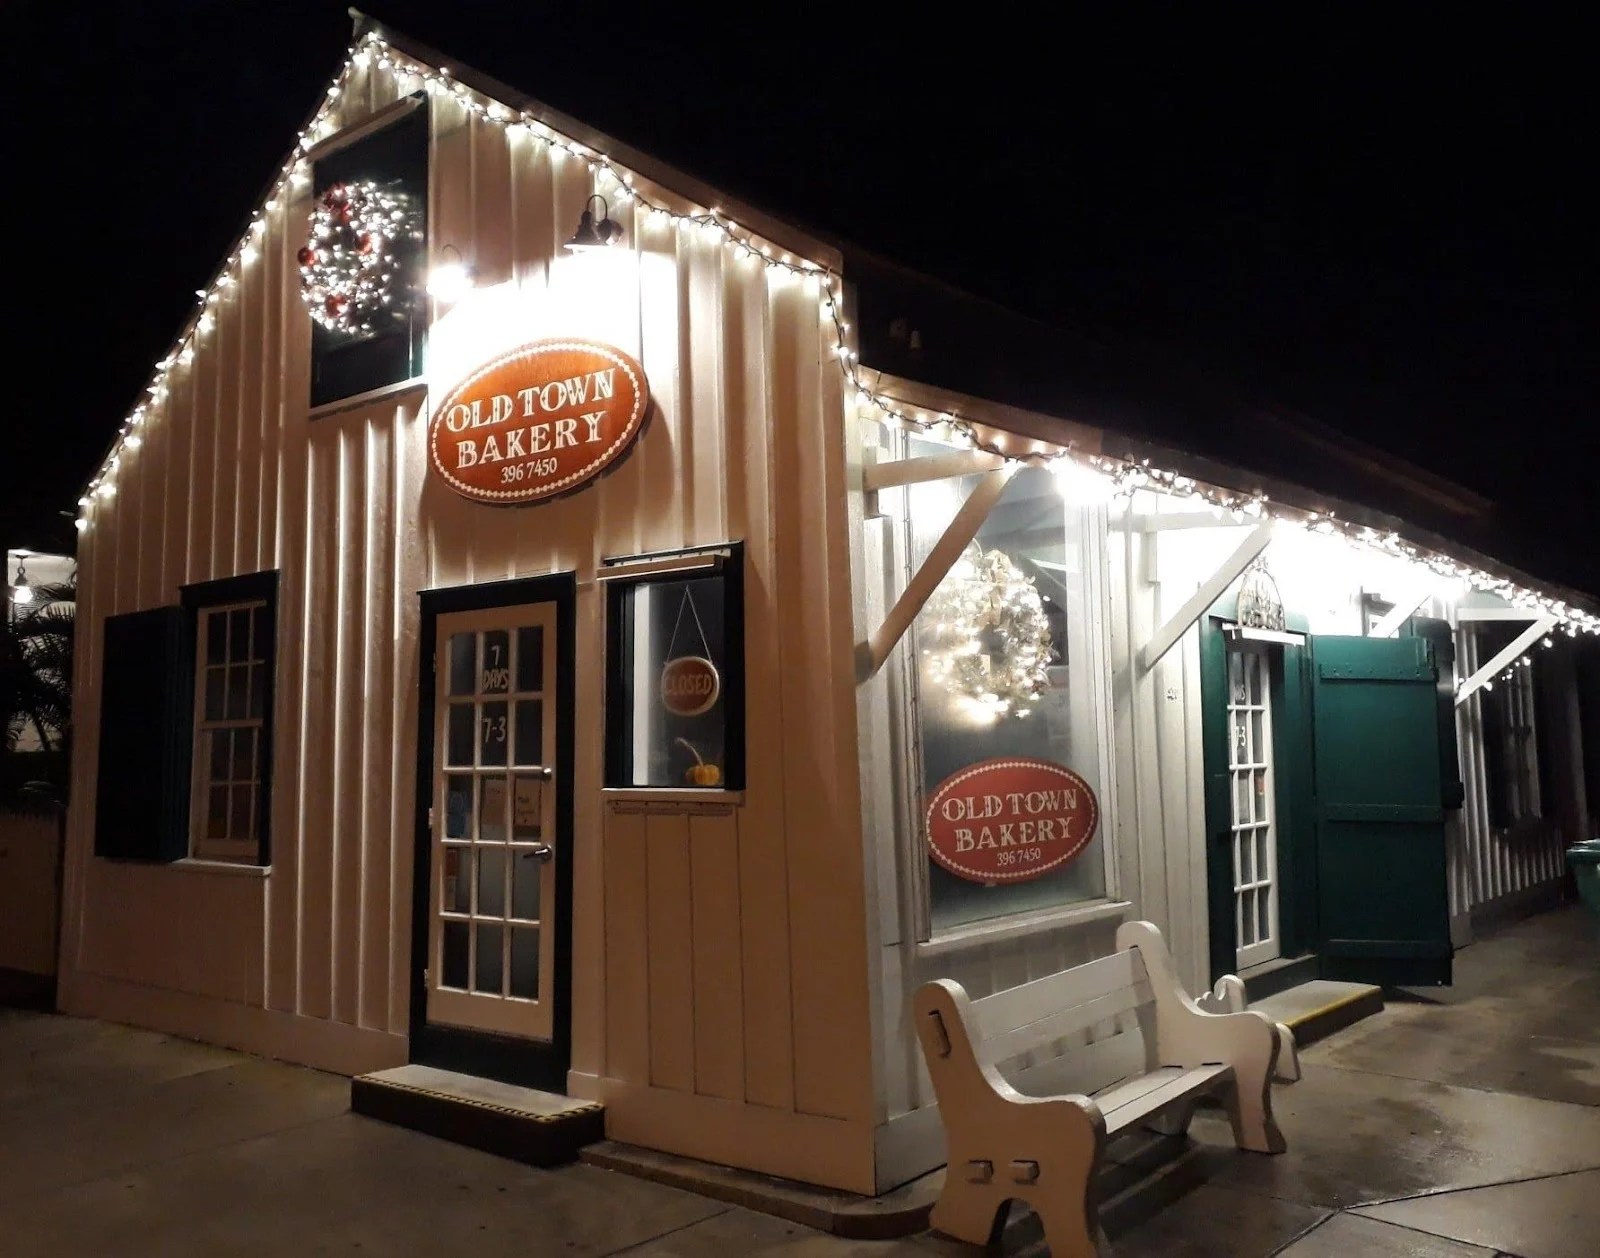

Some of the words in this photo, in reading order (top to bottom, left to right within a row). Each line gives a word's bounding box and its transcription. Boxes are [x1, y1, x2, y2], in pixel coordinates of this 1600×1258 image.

[446, 394, 513, 433] OLD
[517, 367, 616, 417] TOWN
[456, 411, 607, 469] BAKERY
[501, 463, 524, 484] 396
[526, 457, 558, 479] 7450
[491, 644, 500, 666] 7
[482, 668, 509, 690] DAYS
[665, 674, 712, 695] CLOSED
[482, 716, 506, 743] 7-3
[942, 794, 1003, 822] OLD
[1006, 788, 1078, 815] TOWN
[954, 817, 1074, 852] BAKERY
[997, 850, 1016, 867] 396
[1018, 847, 1041, 863] 7450
